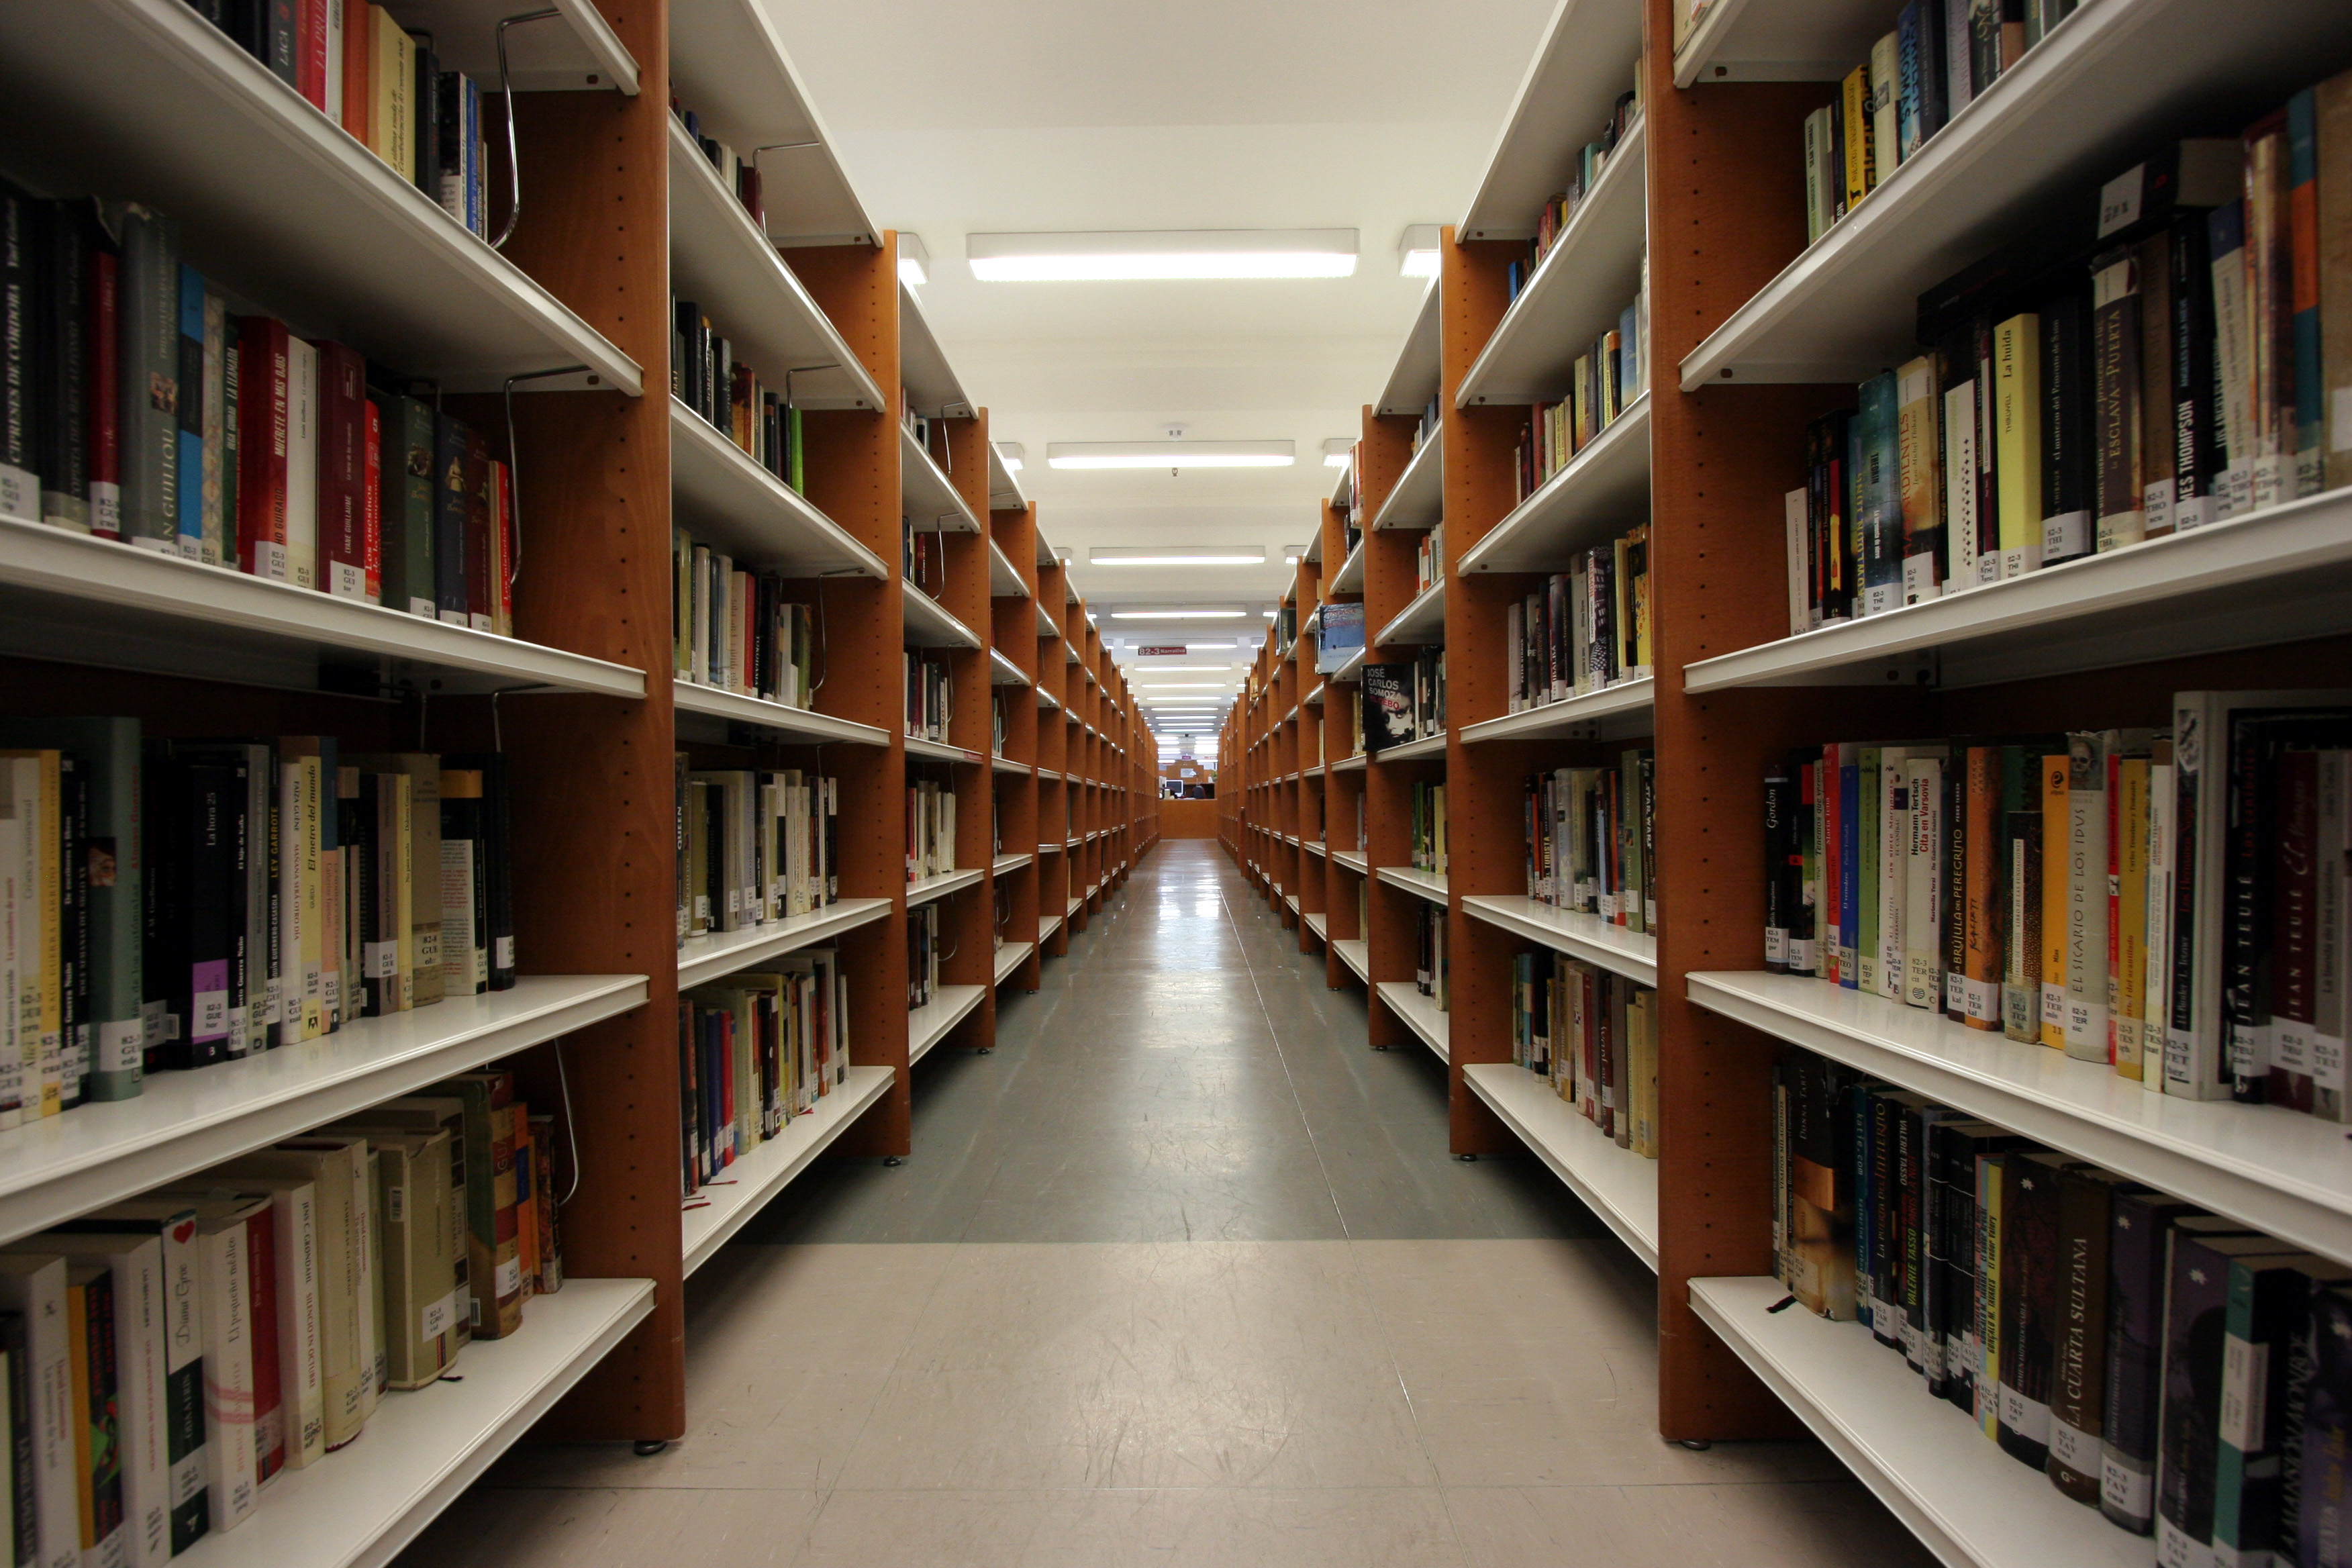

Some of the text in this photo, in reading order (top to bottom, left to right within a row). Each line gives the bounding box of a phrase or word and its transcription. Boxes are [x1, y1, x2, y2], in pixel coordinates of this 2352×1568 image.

[226, 348, 238, 387] LLAMADA
[2003, 330, 2012, 379] La huida
[275, 352, 287, 413] EN MIS OJOS
[2108, 307, 2122, 458] ESCLAVA PUERTA
[2179, 401, 2194, 472] THOMPSON
[161, 428, 175, 517] GUILLOU
[1900, 413, 1911, 512] ARDIENTES
[344, 495, 353, 532] GUILLAUME
[2047, 527, 2062, 537] 82-3
[2048, 537, 2063, 546] THI
[1367, 666, 1385, 678] JOSÉ
[1369, 678, 1399, 690] CARLOS
[1369, 687, 1402, 701] SOMOZA
[206, 792, 216, 846] La hora 25
[307, 765, 316, 872] El metro del mundo
[1767, 789, 1777, 829] Gordon
[1911, 778, 1919, 856] Hermann Tertsch
[1919, 778, 1929, 853] Cita en Varsovia
[238, 838, 244, 846] de
[271, 806, 279, 879] LEY GARROTE
[1952, 828, 1963, 899] PEREGRINO
[2071, 850, 2085, 993] EL SICARIO DE LOS
[2237, 875, 2253, 948] TEULÉ
[1840, 950, 1851, 959] 82-3
[1952, 912, 1964, 962] BRÚJULA
[1839, 961, 1852, 969] TEO
[1912, 957, 1928, 967] 82-3
[1912, 967, 1928, 976] TER
[1955, 963, 1961, 973] LA
[2126, 934, 2134, 979] acantilado
[1949, 975, 1963, 985] 82-3
[1949, 985, 1964, 994] TER
[2046, 993, 2061, 1002] 82-3
[2237, 965, 2253, 1027] JEAN
[206, 1003, 222, 1011] 82-3
[206, 1012, 223, 1020] GUE
[1967, 1001, 1981, 1010] TER
[2046, 1001, 2062, 1012] TER
[2071, 1007, 2088, 1017] 82-3
[2072, 1016, 2088, 1025] TER
[2052, 1025, 2061, 1034] 11
[1799, 1108, 1808, 1140] DONNA
[1857, 1113, 1865, 1175] katie.com
[1899, 1119, 1908, 1186] VALERIE TASSO
[303, 1202, 311, 1221] JENS
[1988, 1215, 1998, 1239] Valery
[228, 1236, 238, 1276] médico
[304, 1233, 313, 1285] GRØNDAHL
[1877, 1245, 1885, 1258] LA
[1908, 1228, 1919, 1306] VALERIE TASSO
[228, 1278, 240, 1325] pequeño
[1988, 1276, 1997, 1308] TAVARES
[176, 1300, 190, 1346] Diana
[305, 1291, 314, 1336] SILENCIO
[430, 1315, 444, 1326] GRO
[307, 1338, 315, 1349] EN
[2068, 1238, 2088, 1428] LA CUARTA SULTANA
